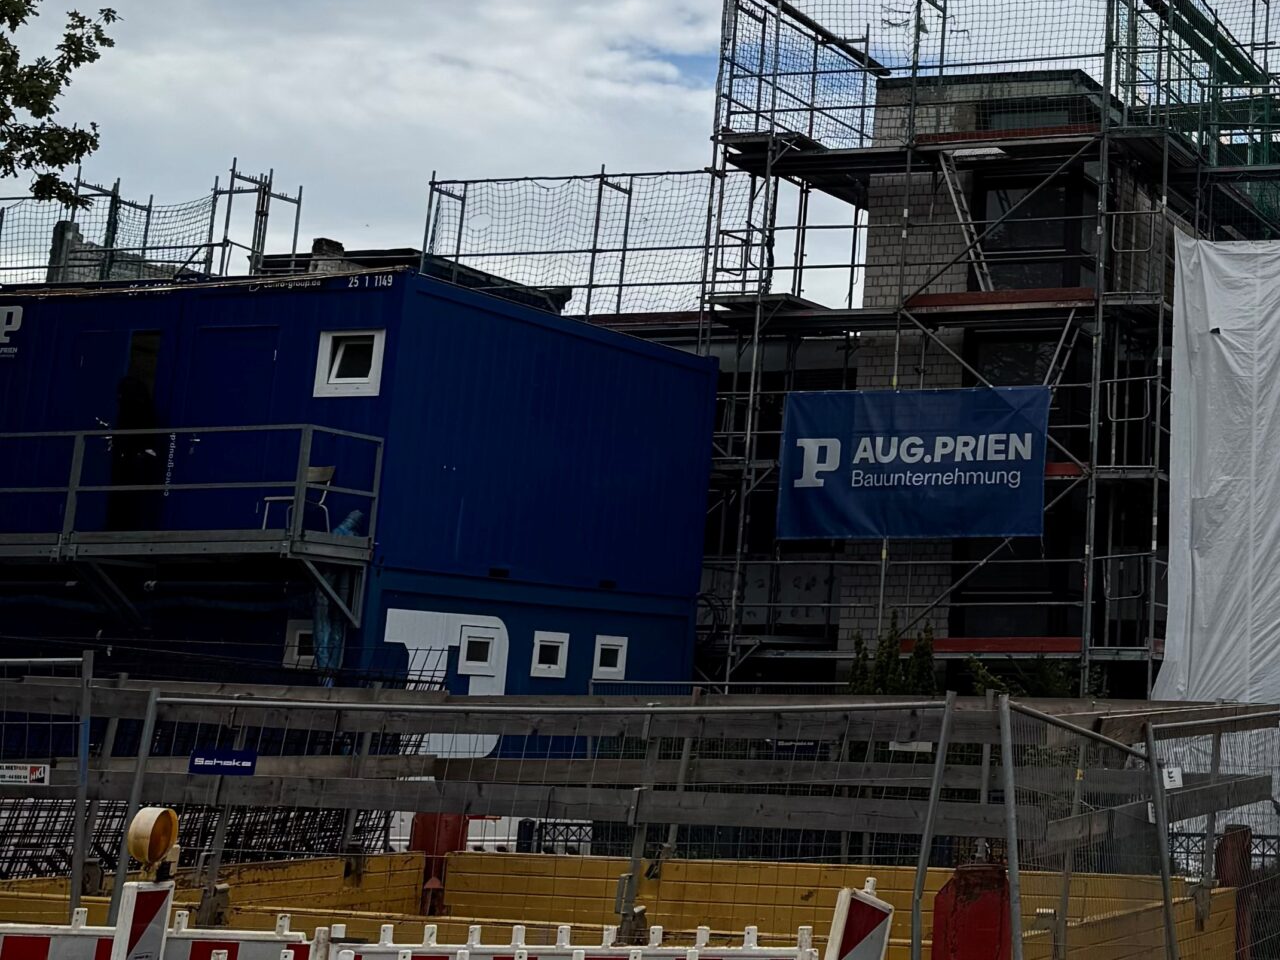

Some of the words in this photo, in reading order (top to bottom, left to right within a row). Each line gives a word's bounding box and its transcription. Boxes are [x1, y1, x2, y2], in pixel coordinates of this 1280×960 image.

[348, 276, 359, 288] 25
[852, 433, 1032, 464] AUG.PRIEN
[793, 438, 841, 488] P
[851, 468, 1021, 488] Bauunternehmung
